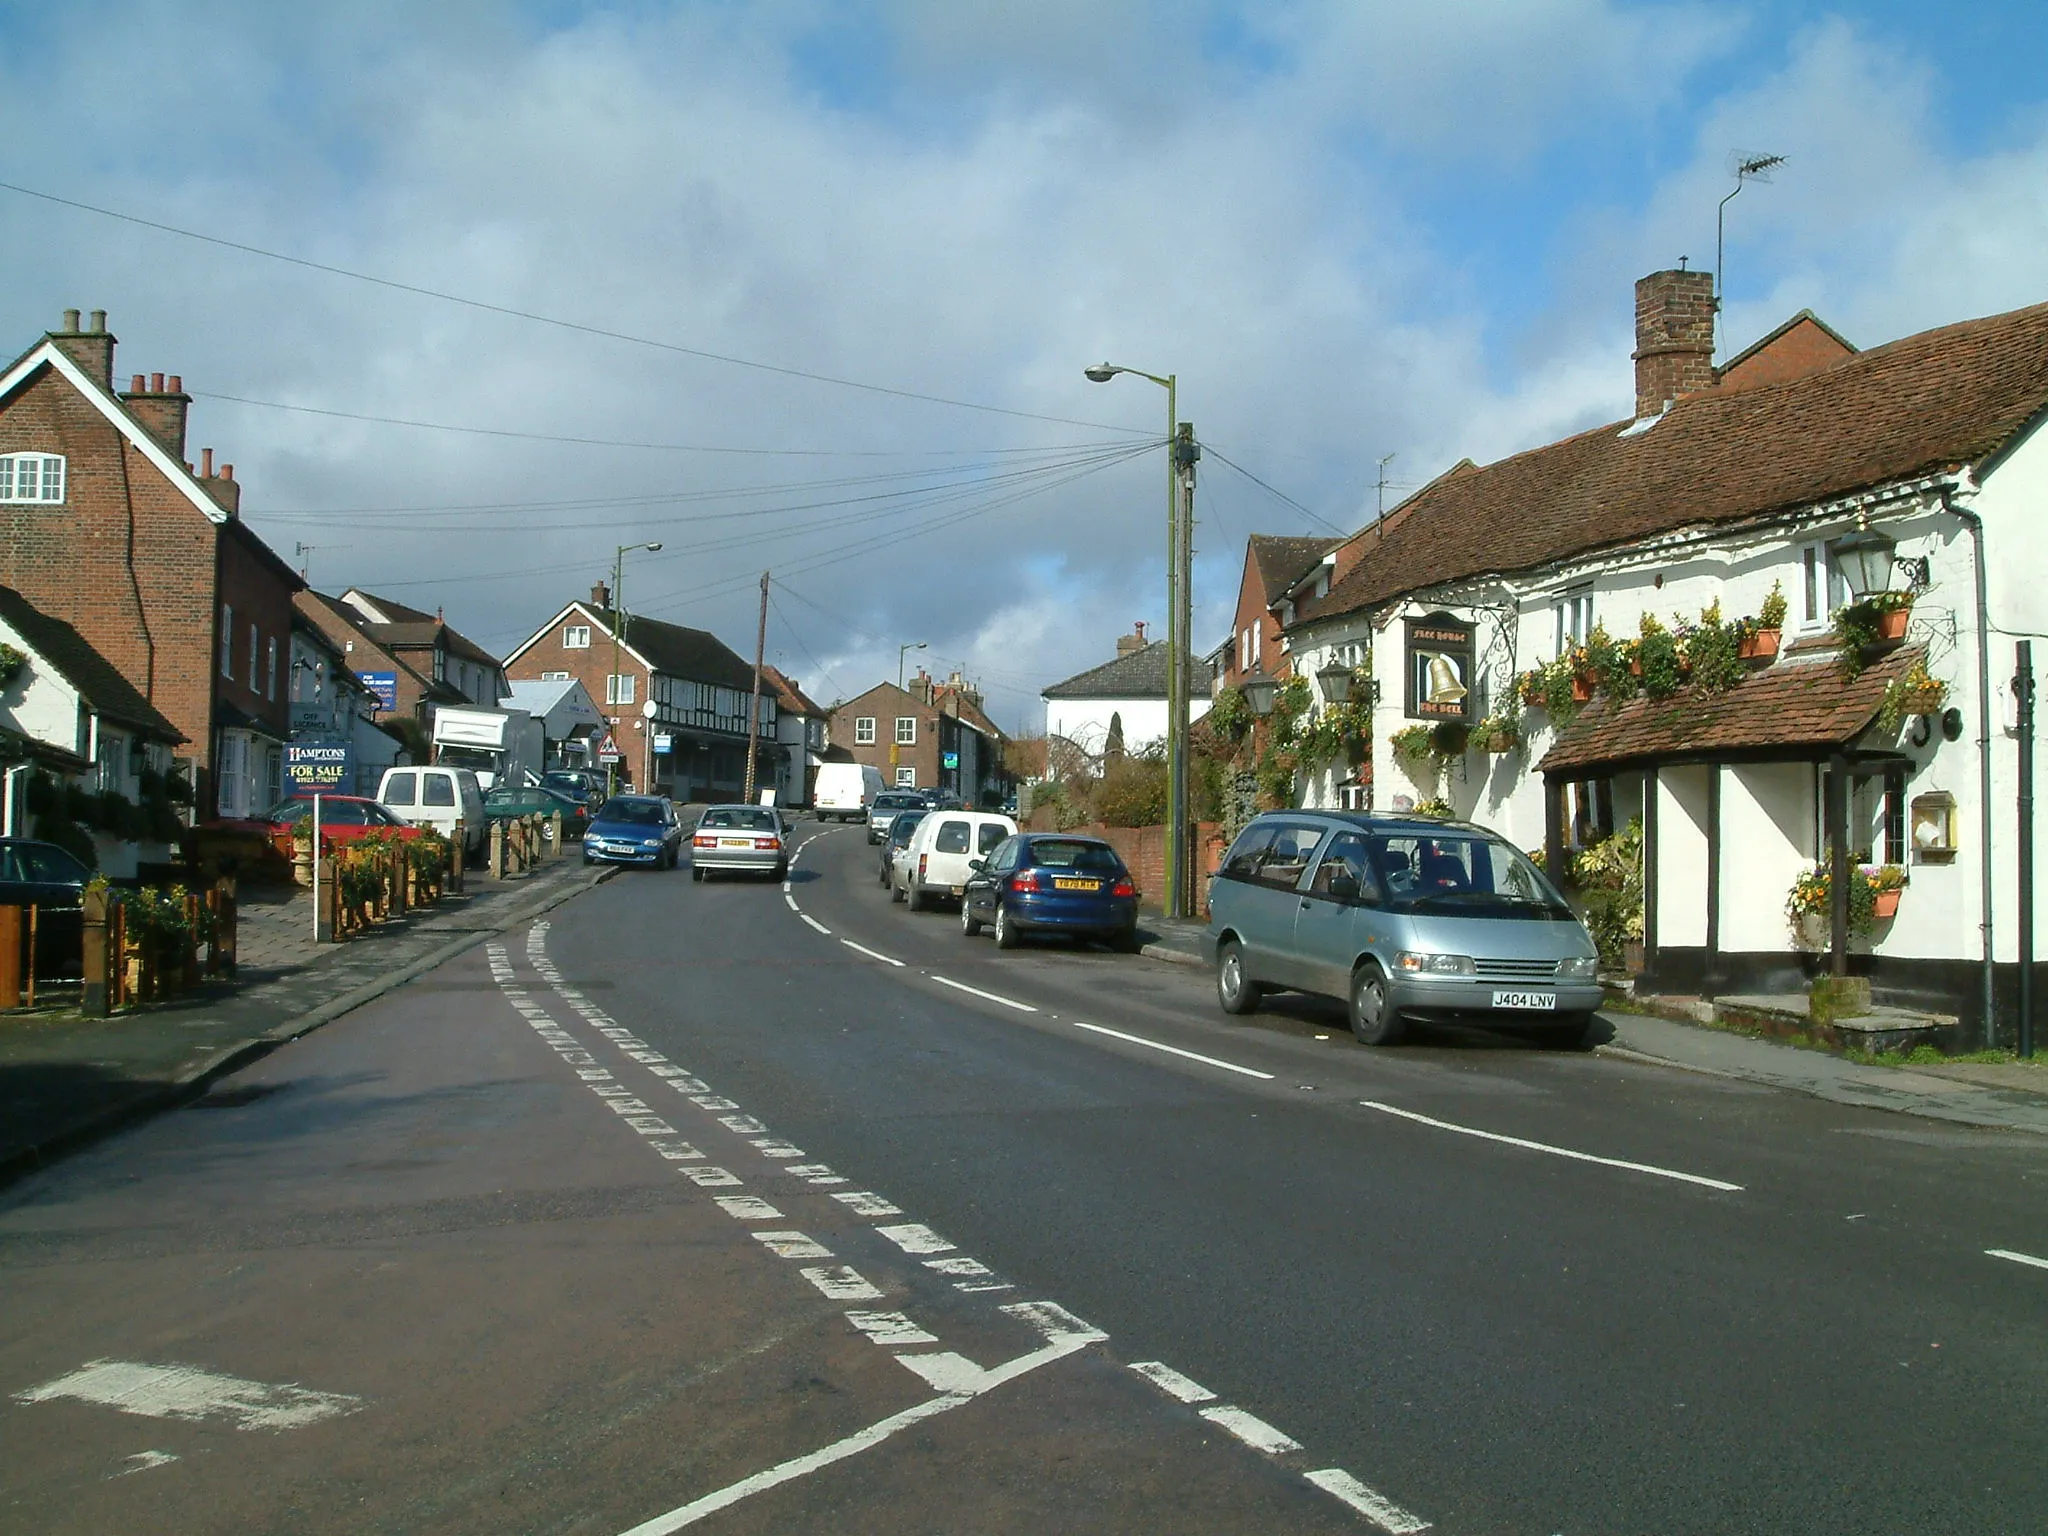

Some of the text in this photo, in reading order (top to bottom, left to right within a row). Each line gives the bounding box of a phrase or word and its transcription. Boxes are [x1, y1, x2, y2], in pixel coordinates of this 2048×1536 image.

[289, 748, 345, 761] HAMPTONS
[290, 766, 343, 777] FOR SALE
[1495, 994, 1555, 1007] J404 LNV
